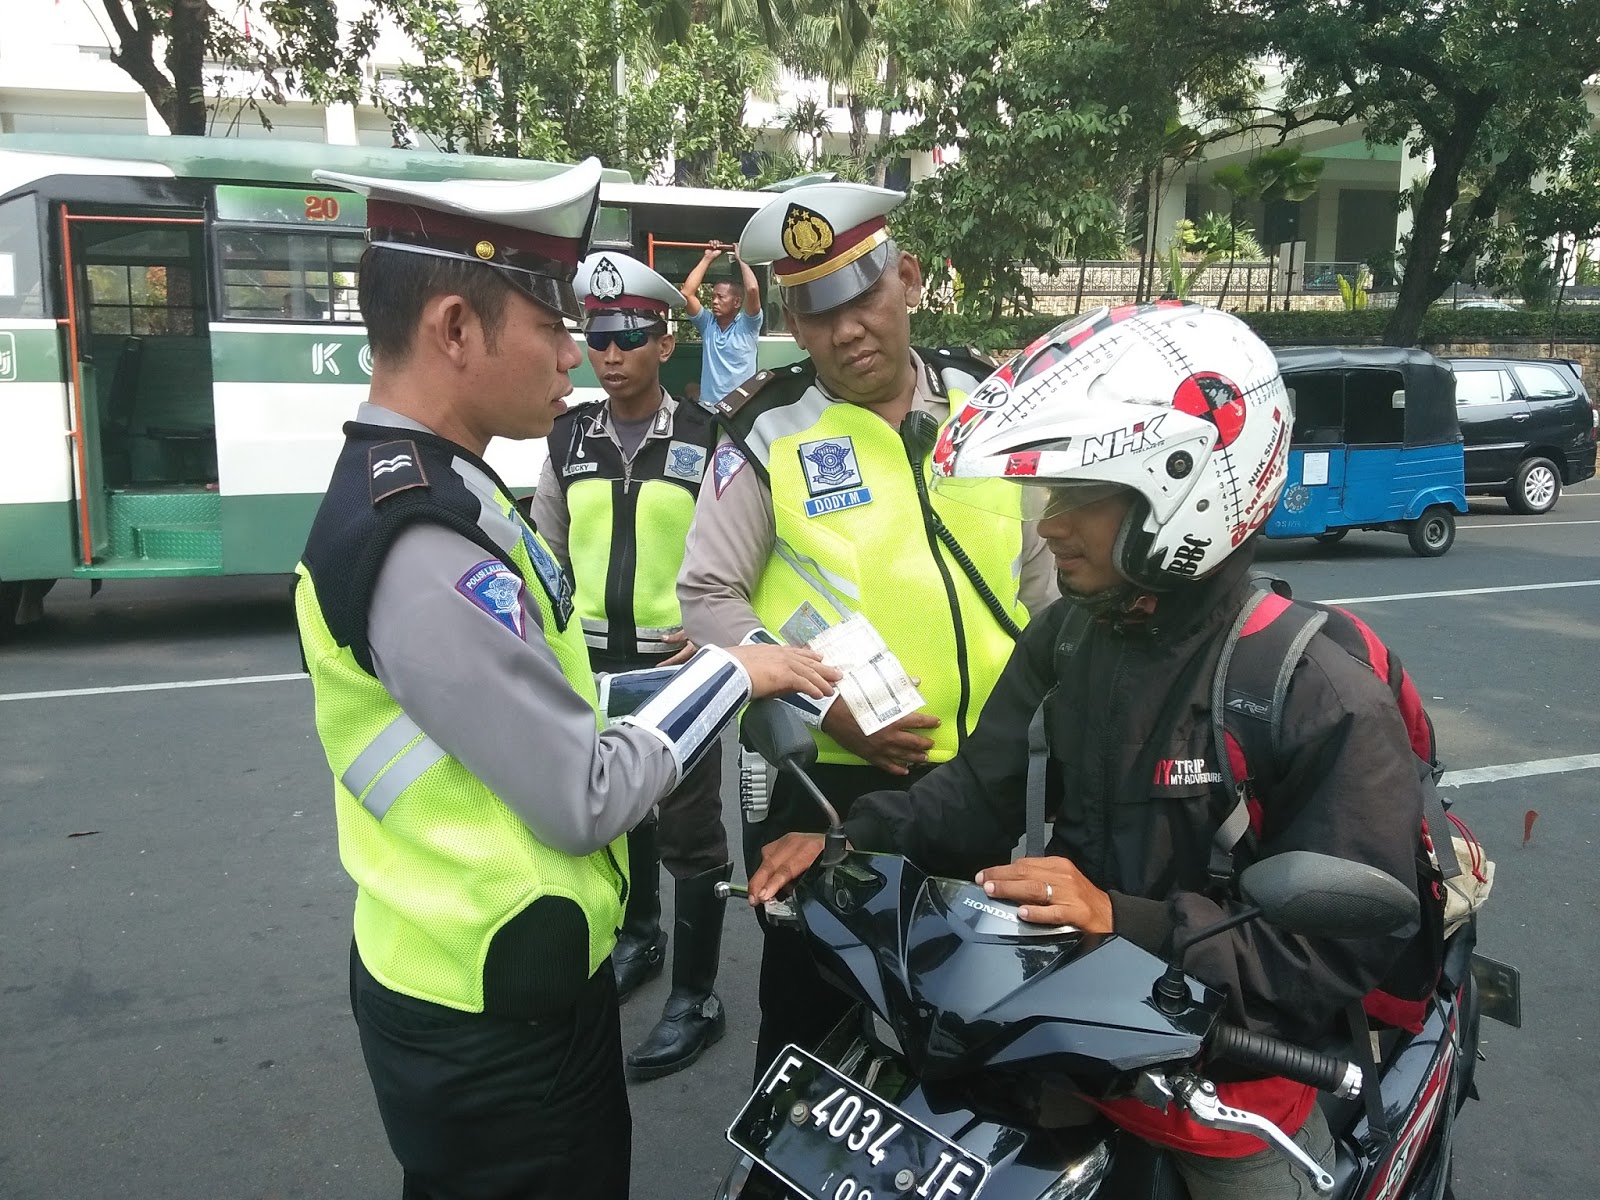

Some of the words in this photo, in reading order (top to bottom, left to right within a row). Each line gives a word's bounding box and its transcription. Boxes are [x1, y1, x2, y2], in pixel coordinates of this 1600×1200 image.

[305, 196, 340, 222] 20
[1081, 412, 1168, 467] NHK
[1248, 460, 1266, 487] NHK
[1264, 427, 1278, 457] Shell
[814, 491, 861, 513] DODY.M
[465, 569, 485, 590] POLISI
[1174, 758, 1205, 774] TRIP
[1170, 774, 1183, 785] MY
[962, 898, 1019, 923] HONDA
[765, 1056, 803, 1094] F
[811, 1087, 902, 1166] 4034
